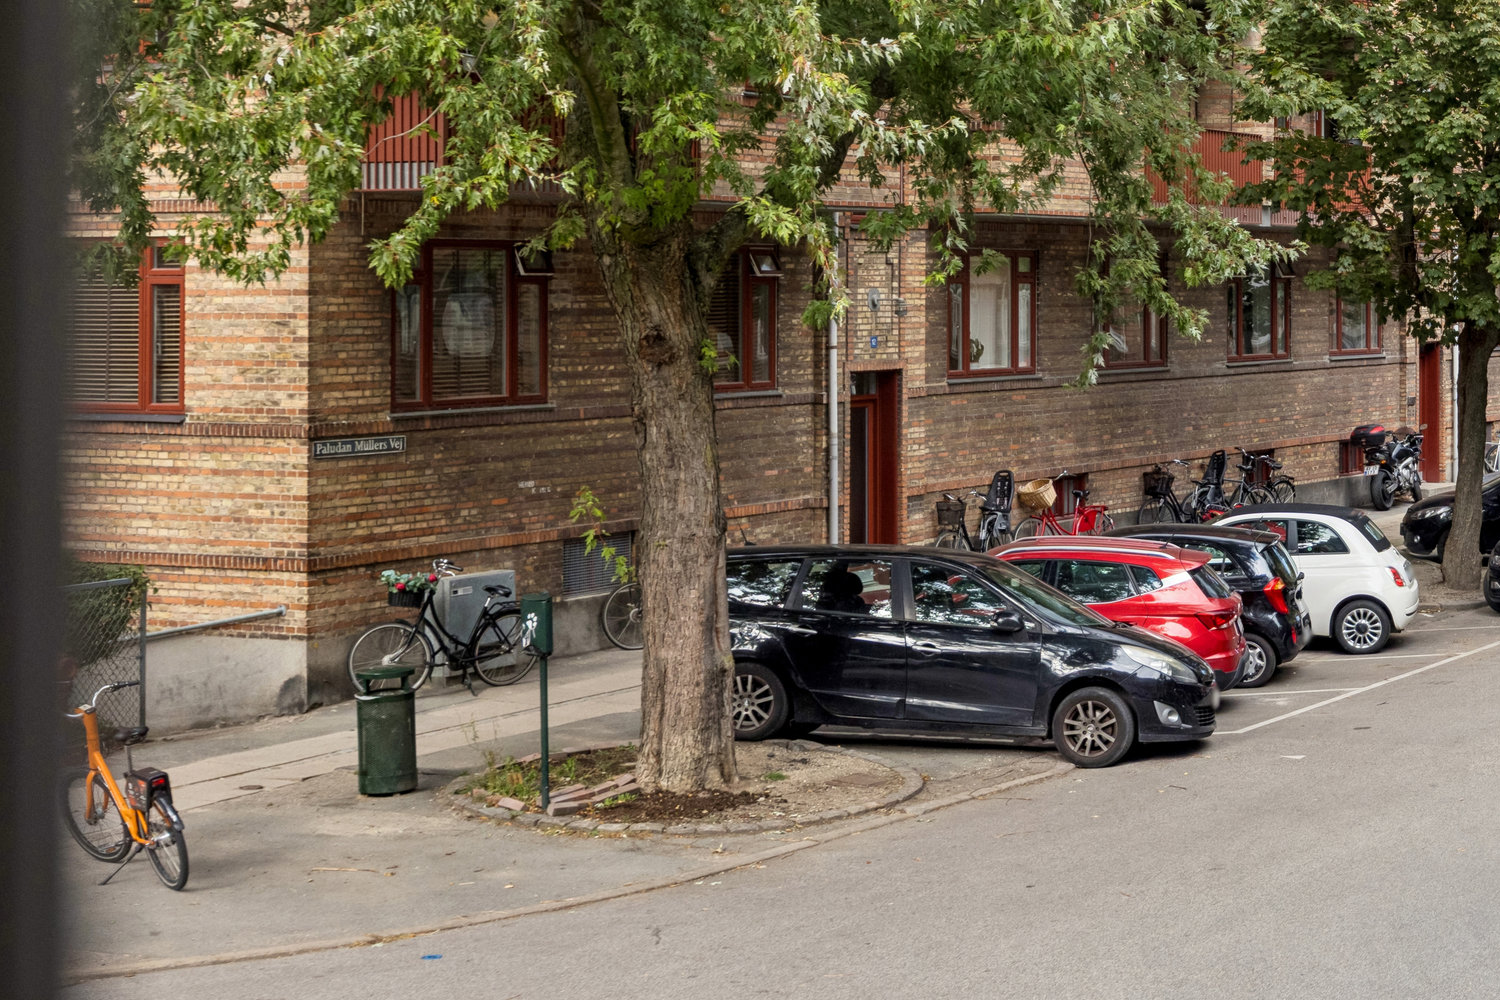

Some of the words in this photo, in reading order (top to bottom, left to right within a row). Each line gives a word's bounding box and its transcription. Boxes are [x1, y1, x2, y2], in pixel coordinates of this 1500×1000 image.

[316, 442, 352, 454] Paludan
[354, 440, 387, 452] Müllers
[389, 438, 403, 450] Vej
